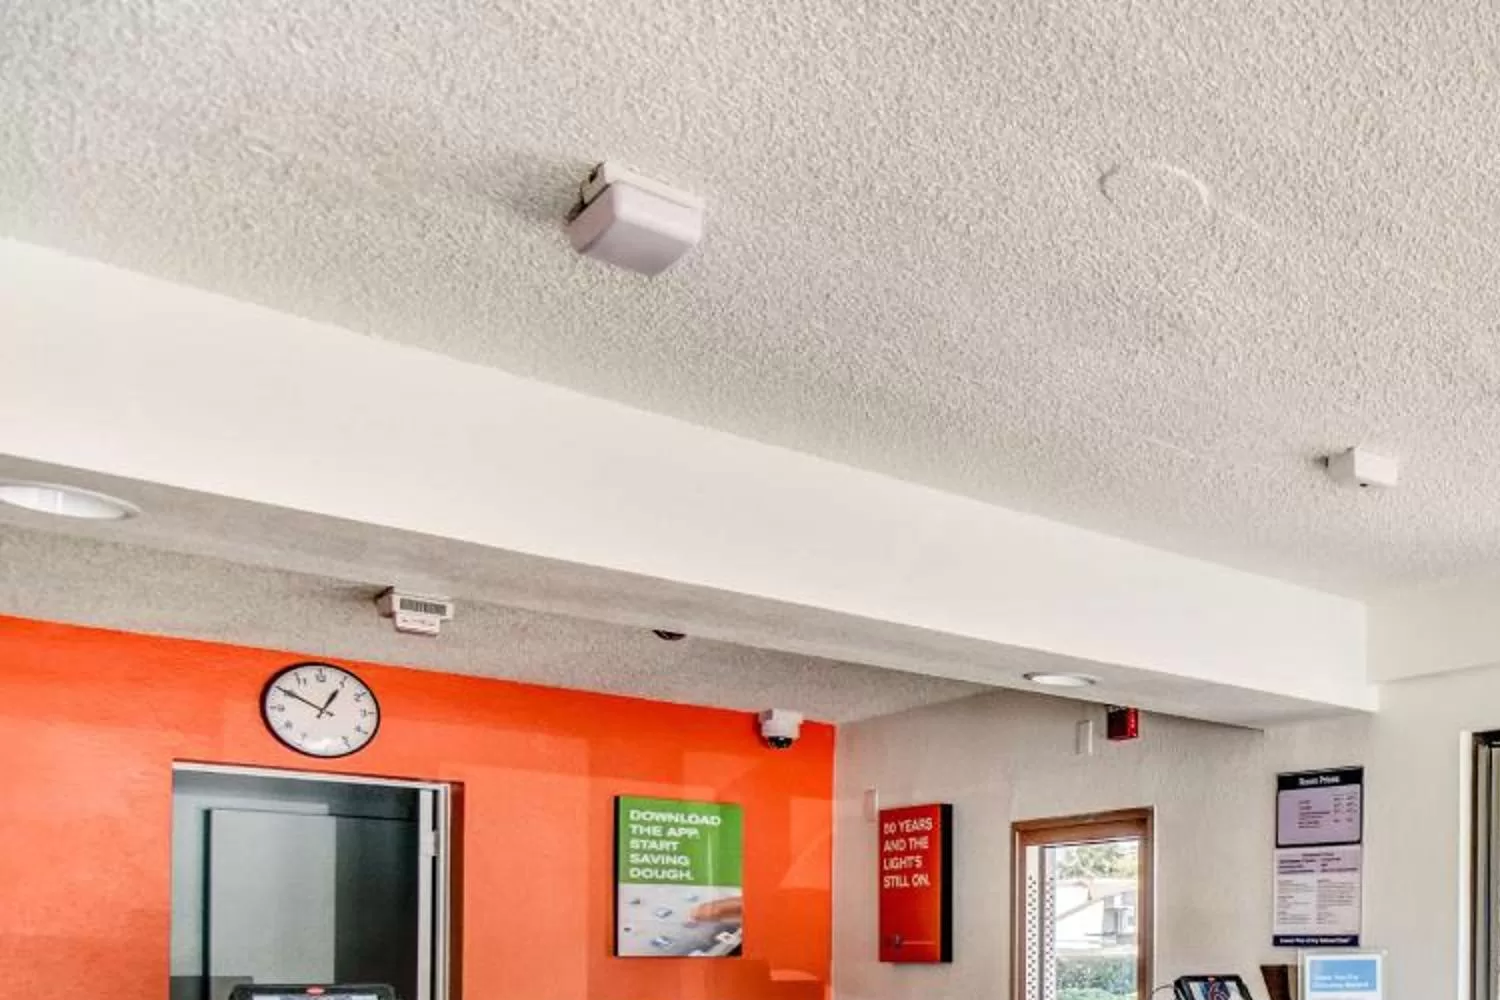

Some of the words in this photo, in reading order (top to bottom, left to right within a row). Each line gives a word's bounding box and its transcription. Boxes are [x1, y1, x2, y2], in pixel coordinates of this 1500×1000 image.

[628, 809, 722, 827] DOWNLOAD
[899, 817, 933, 833] YEARS
[630, 823, 663, 837] THE
[629, 838, 680, 852] START
[883, 838, 907, 853] AND
[908, 835, 930, 850] THE
[629, 853, 690, 867] SAVING
[628, 866, 695, 881] DOUGH.
[883, 875, 911, 889] STILL
